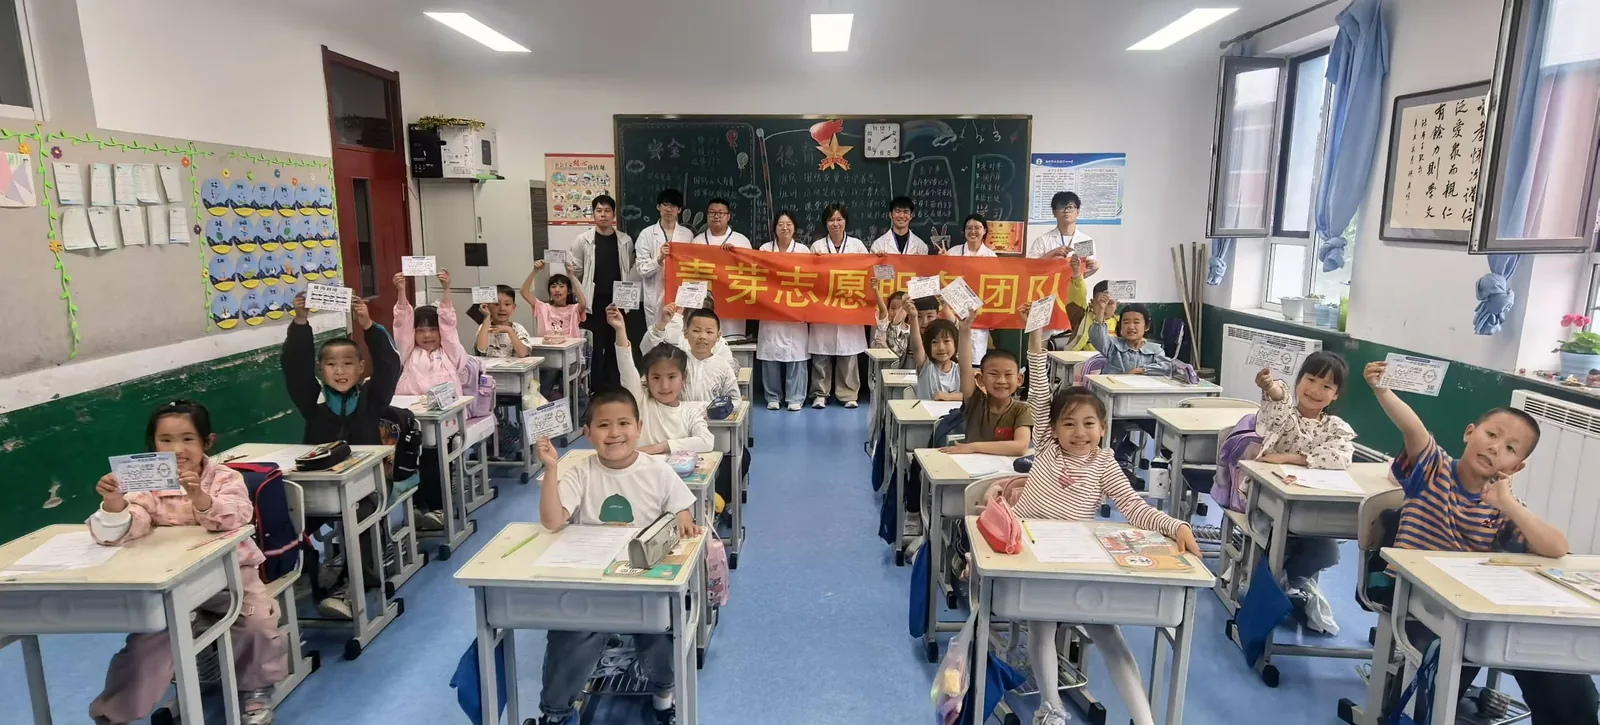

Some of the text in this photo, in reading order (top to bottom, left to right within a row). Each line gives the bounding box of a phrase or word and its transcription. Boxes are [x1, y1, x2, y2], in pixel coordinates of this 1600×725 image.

[676, 258, 1067, 315] 青芽志愿团队
